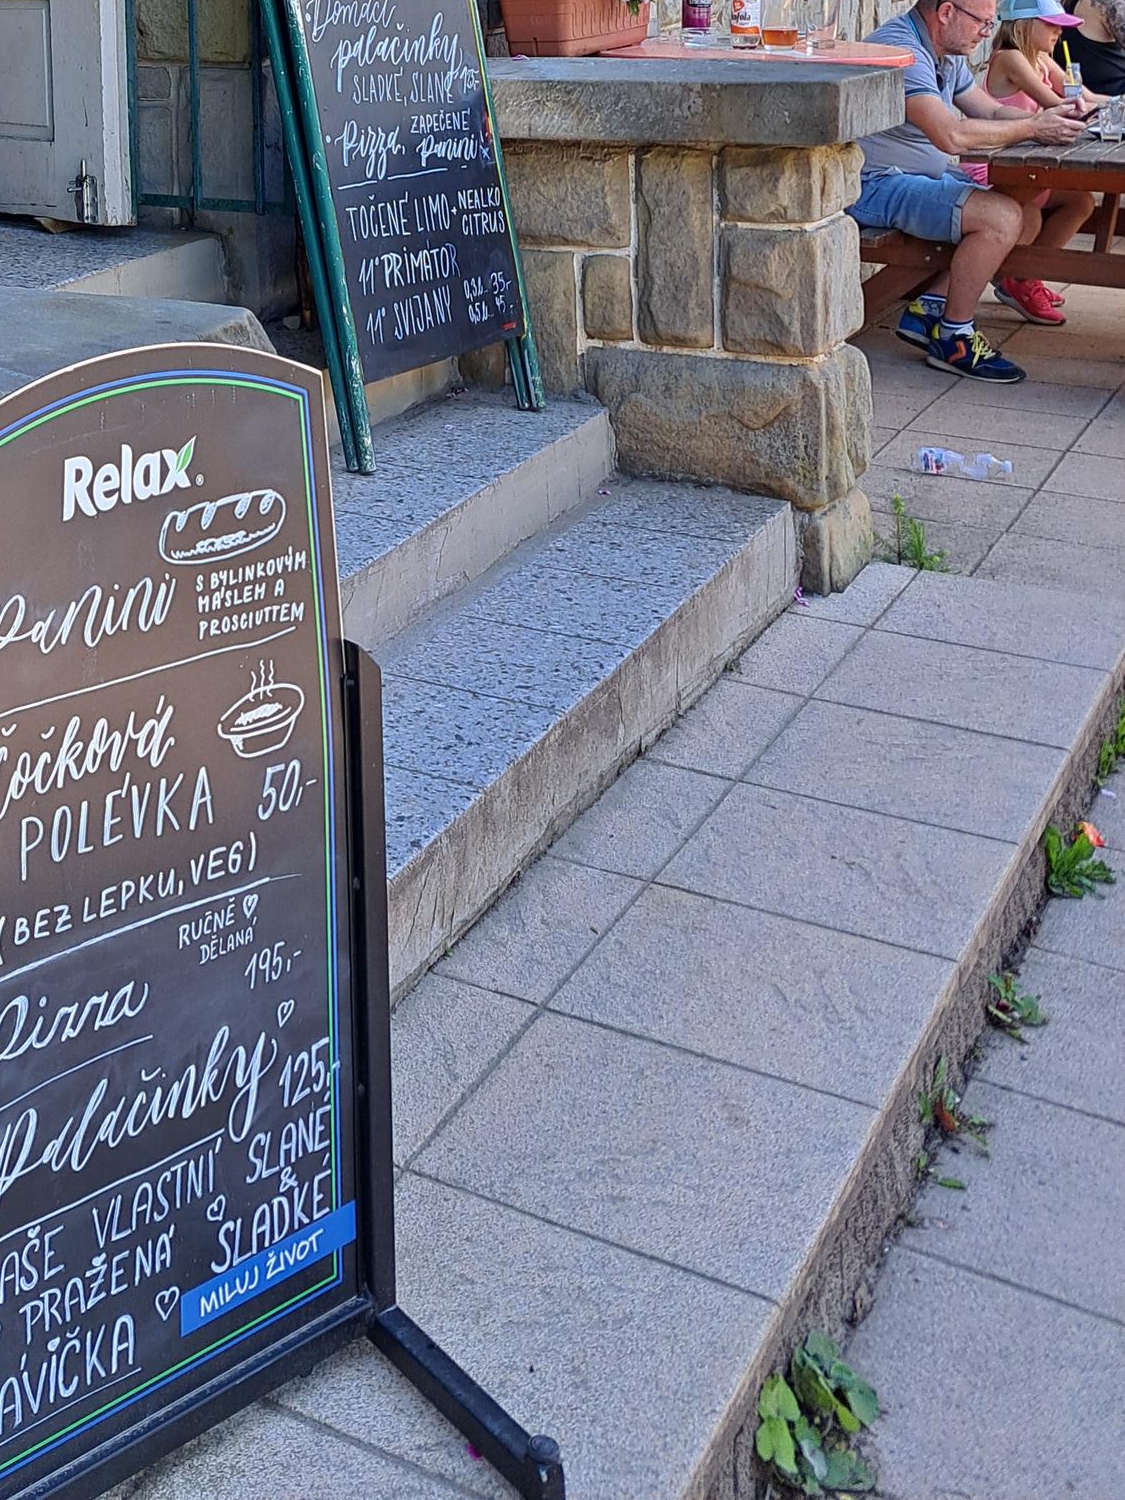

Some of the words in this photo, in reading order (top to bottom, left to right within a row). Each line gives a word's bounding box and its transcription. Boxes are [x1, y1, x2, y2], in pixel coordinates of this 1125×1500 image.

[330, 12, 462, 93] palačinky
[410, 108, 470, 134] ZAPEČENÉ
[345, 191, 412, 241] TOČENÉ
[414, 192, 450, 233] LIMO
[457, 185, 501, 210] NEALKO
[462, 210, 505, 236] CITRUS
[381, 239, 461, 288] PRIMÁTOR
[394, 284, 452, 340] SVIJANY
[62, 434, 196, 522] Relax
[195, 573, 204, 592] S
[209, 545, 307, 591] BYLINKOVÝM
[197, 582, 266, 614] MÁSLEM
[274, 578, 286, 598] A
[198, 602, 306, 641] PROSCIUTTEM
[21, 766, 214, 881] POLÉVKA
[190, 831, 257, 885] VEG)
[178, 897, 236, 950] RUČNĚ
[199, 916, 258, 966] DĚLANÁ
[245, 1091, 331, 1184] SLANÉ
[92, 1137, 223, 1249] VLASTNÍ
[280, 1166, 300, 1192] &
[211, 1152, 331, 1275] SLADKÉ
[20, 1224, 174, 1345] PRAŽENÁ
[199, 1270, 259, 1317] MILUJ
[266, 1228, 325, 1280] ŽIVOT
